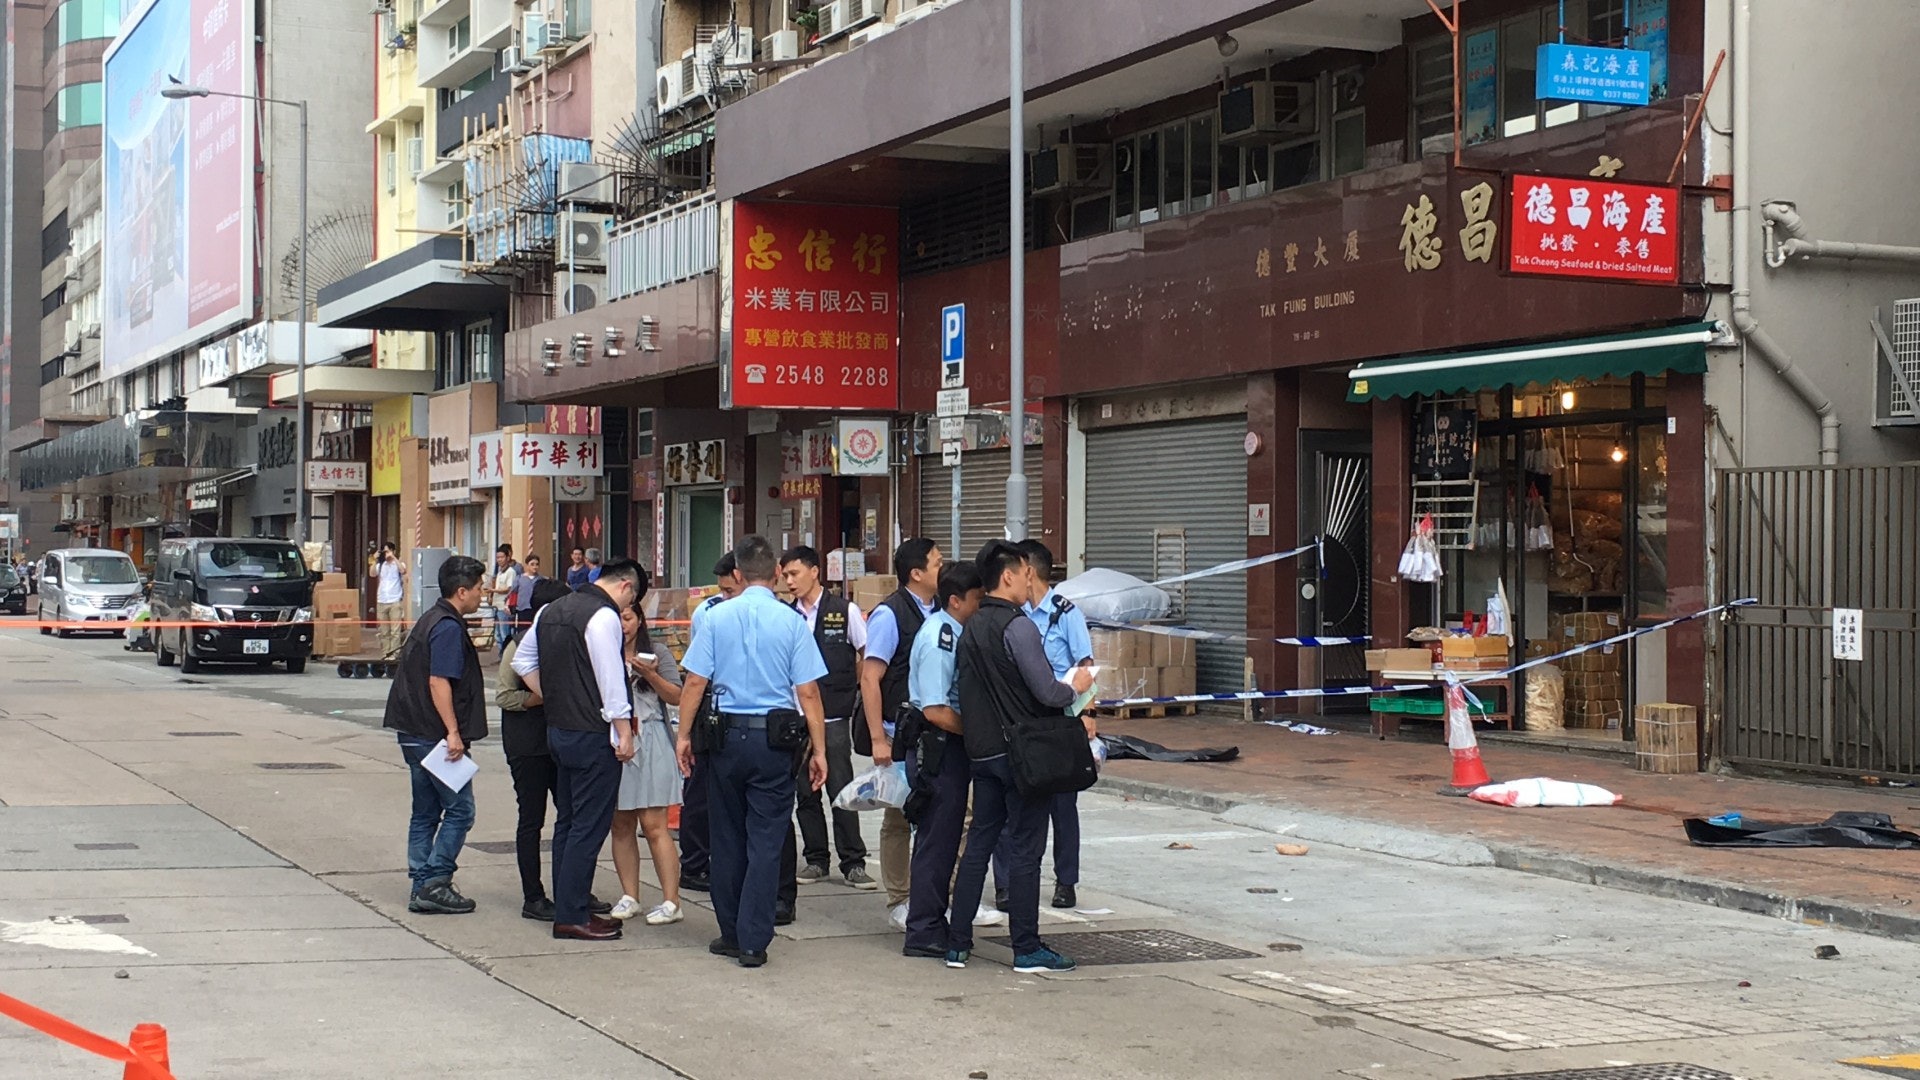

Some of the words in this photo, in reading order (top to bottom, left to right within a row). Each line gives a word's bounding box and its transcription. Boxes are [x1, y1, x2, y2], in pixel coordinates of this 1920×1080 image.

[1561, 50, 1640, 76] 森記海產
[1524, 183, 1666, 235] 德昌海產
[745, 224, 887, 275] 忠信行
[1514, 255, 1530, 265] Tak
[1531, 256, 1559, 269] Cheong
[1561, 258, 1594, 269] Seafood
[1595, 261, 1601, 269] &
[1602, 261, 1624, 271] Dried
[1626, 262, 1651, 272] Salted
[1653, 265, 1673, 274] Meat
[744, 287, 889, 314] 米業有限公司
[1260, 303, 1276, 318] TAK
[1283, 298, 1307, 314] FUNG
[1314, 290, 1355, 310] BUILDING
[744, 328, 889, 351] 專營飲食業批發商
[945, 311, 960, 357] P
[776, 364, 824, 385] 2548
[841, 366, 889, 387] 2288
